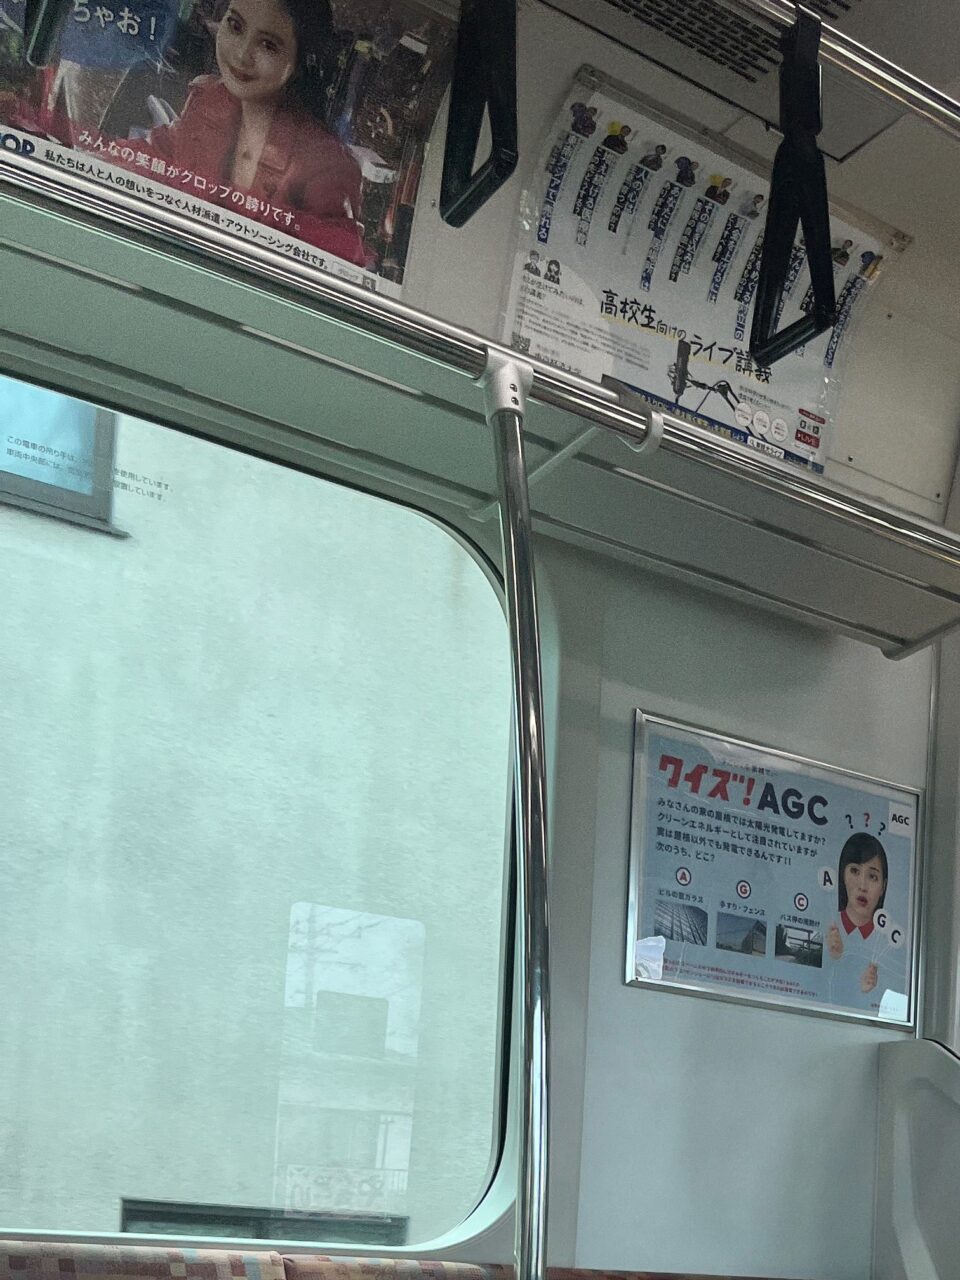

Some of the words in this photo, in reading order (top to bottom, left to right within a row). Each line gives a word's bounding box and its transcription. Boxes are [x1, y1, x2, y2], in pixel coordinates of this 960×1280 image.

[79, 131, 300, 230] みんなの笑顔がグロップの誇りです。
[44, 149, 328, 269] 私たちは人と人の想いをつなぐ人材派遣・アウトソーシング会社です。
[891, 813, 910, 827] AGC
[656, 841, 715, 863] 次のうち、どこ？
[822, 870, 834, 887] A
[876, 912, 887, 929] G
[891, 929, 901, 944] C
